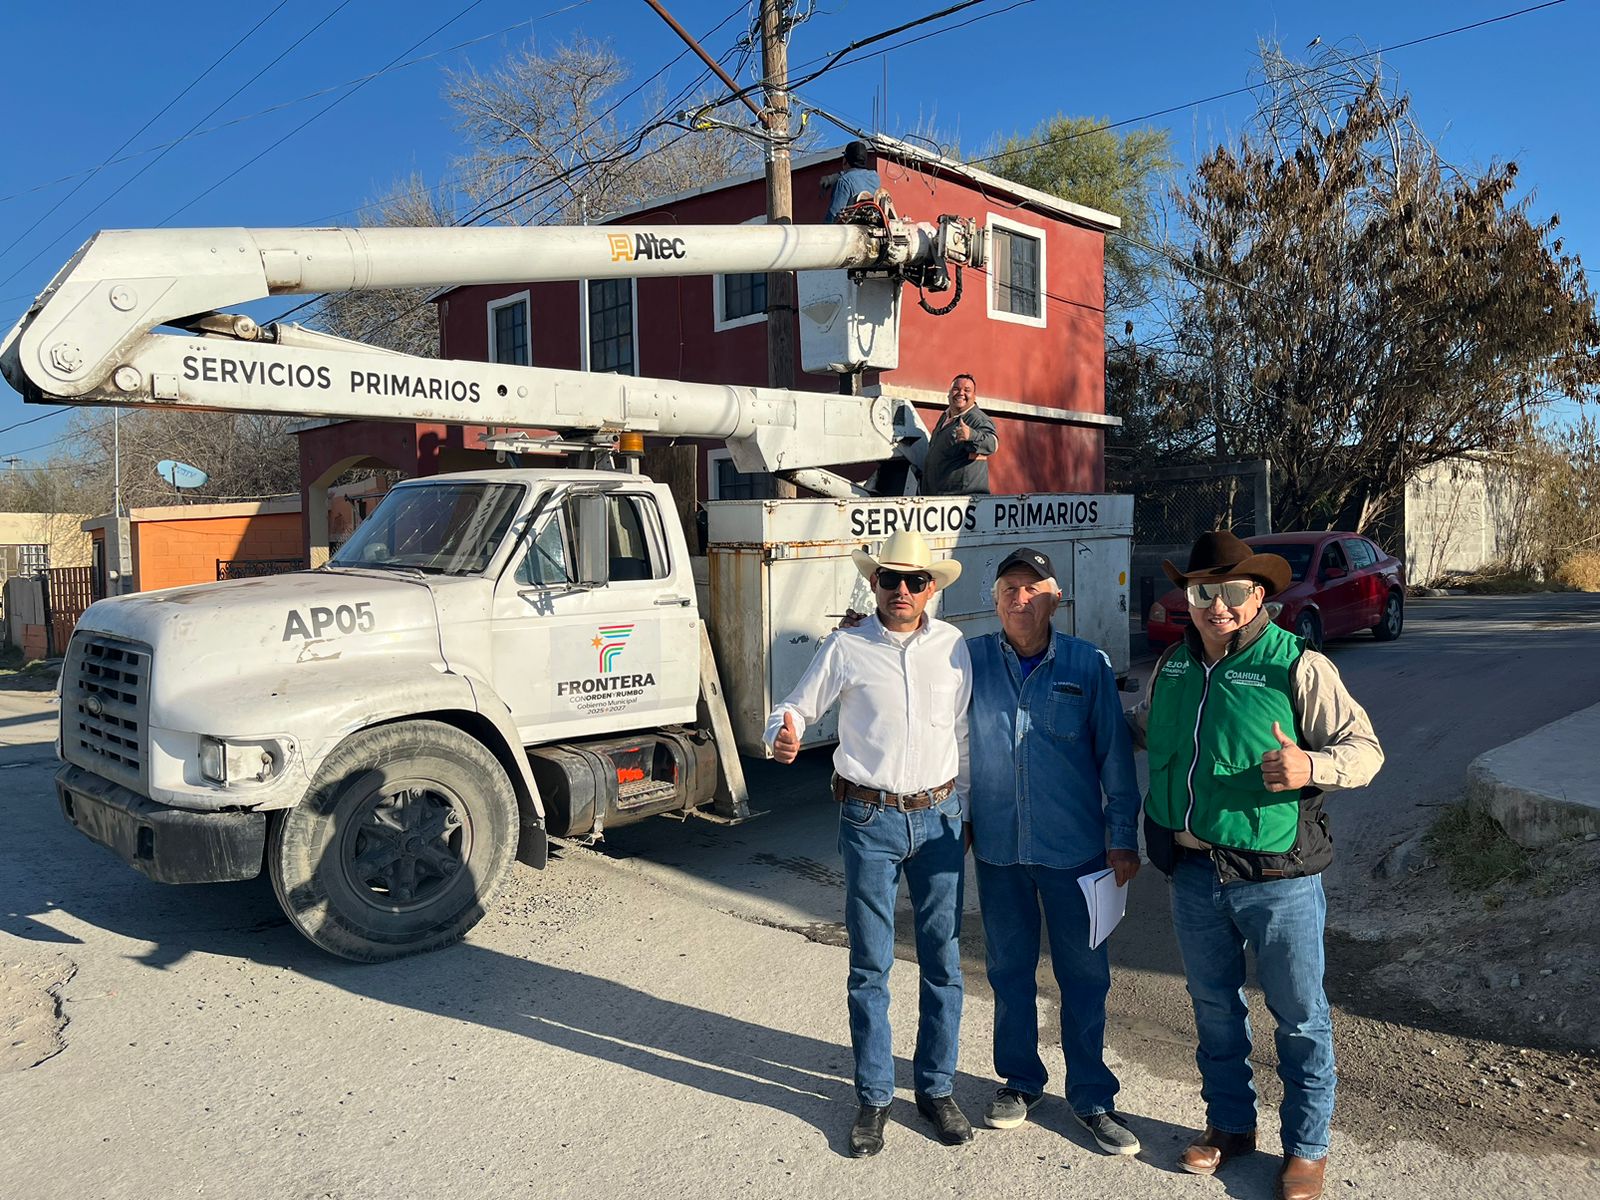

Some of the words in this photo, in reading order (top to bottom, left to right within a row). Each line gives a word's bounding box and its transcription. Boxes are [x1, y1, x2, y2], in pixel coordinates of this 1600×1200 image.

[634, 233, 686, 260] Altec
[183, 355, 331, 390] SERVICIOS
[350, 370, 481, 403] PRIMARIOS
[851, 504, 976, 537] SERVICIOS
[994, 500, 1098, 528] PRIMARIOS
[282, 602, 375, 641] AP05
[557, 673, 656, 697] FRONTERA
[577, 700, 607, 711] Gobierno
[607, 697, 638, 707] Municipal
[587, 707, 604, 715] 2025
[609, 705, 626, 713] 2027
